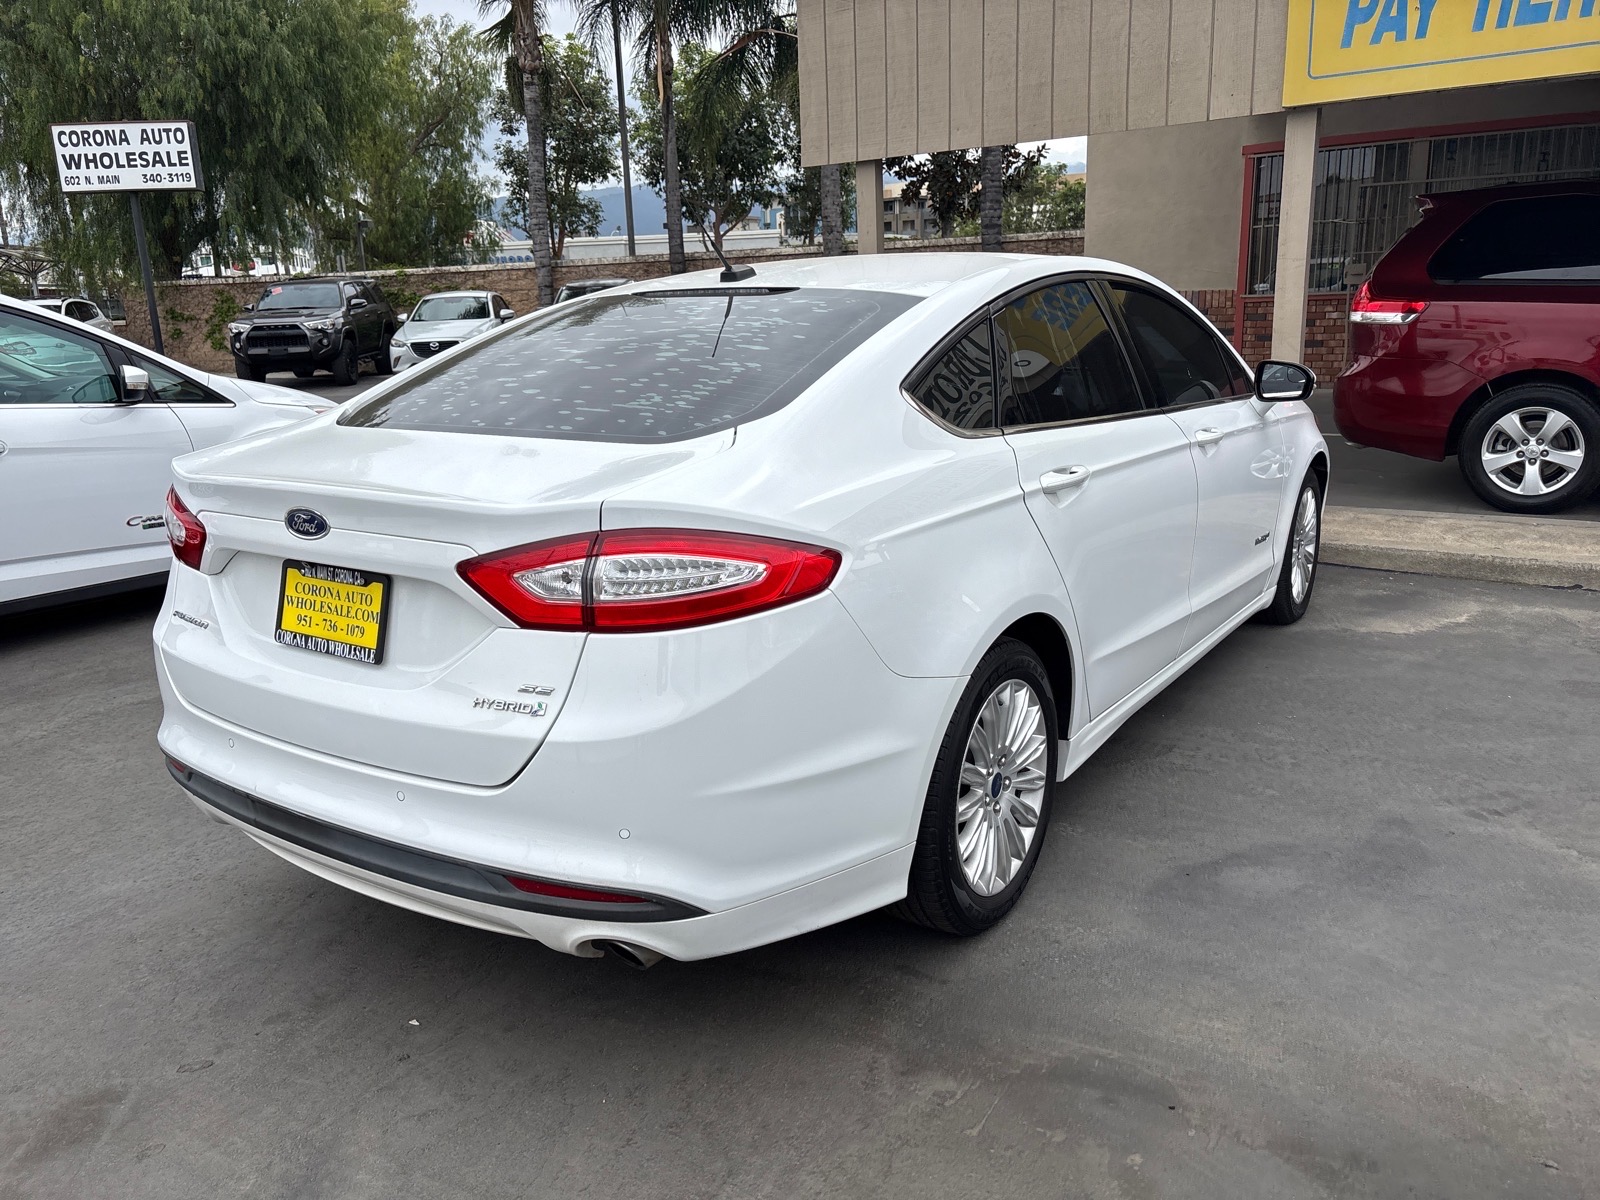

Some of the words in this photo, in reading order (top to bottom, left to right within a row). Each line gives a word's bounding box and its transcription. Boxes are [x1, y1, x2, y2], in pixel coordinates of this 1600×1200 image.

[1340, 0, 1437, 49] PAY
[57, 129, 131, 148] CORONA
[140, 127, 185, 145] AUTO
[61, 150, 190, 170] WHOLESALE
[64, 175, 81, 186] 602
[85, 175, 94, 185] N.
[97, 174, 121, 185] MAIN
[141, 172, 192, 184] 340-3119
[292, 513, 318, 533] Ford
[295, 581, 341, 601] CORONA
[344, 591, 373, 607] AUTO
[285, 594, 380, 625] WHOLESALE.COM
[296, 613, 313, 628] 951
[322, 618, 338, 632] 736
[345, 623, 365, 638] 1079
[306, 637, 328, 653] AUTO
[328, 640, 376, 663] WHOLESALE
[517, 683, 555, 696] SE
[473, 697, 533, 715] HYBRID
